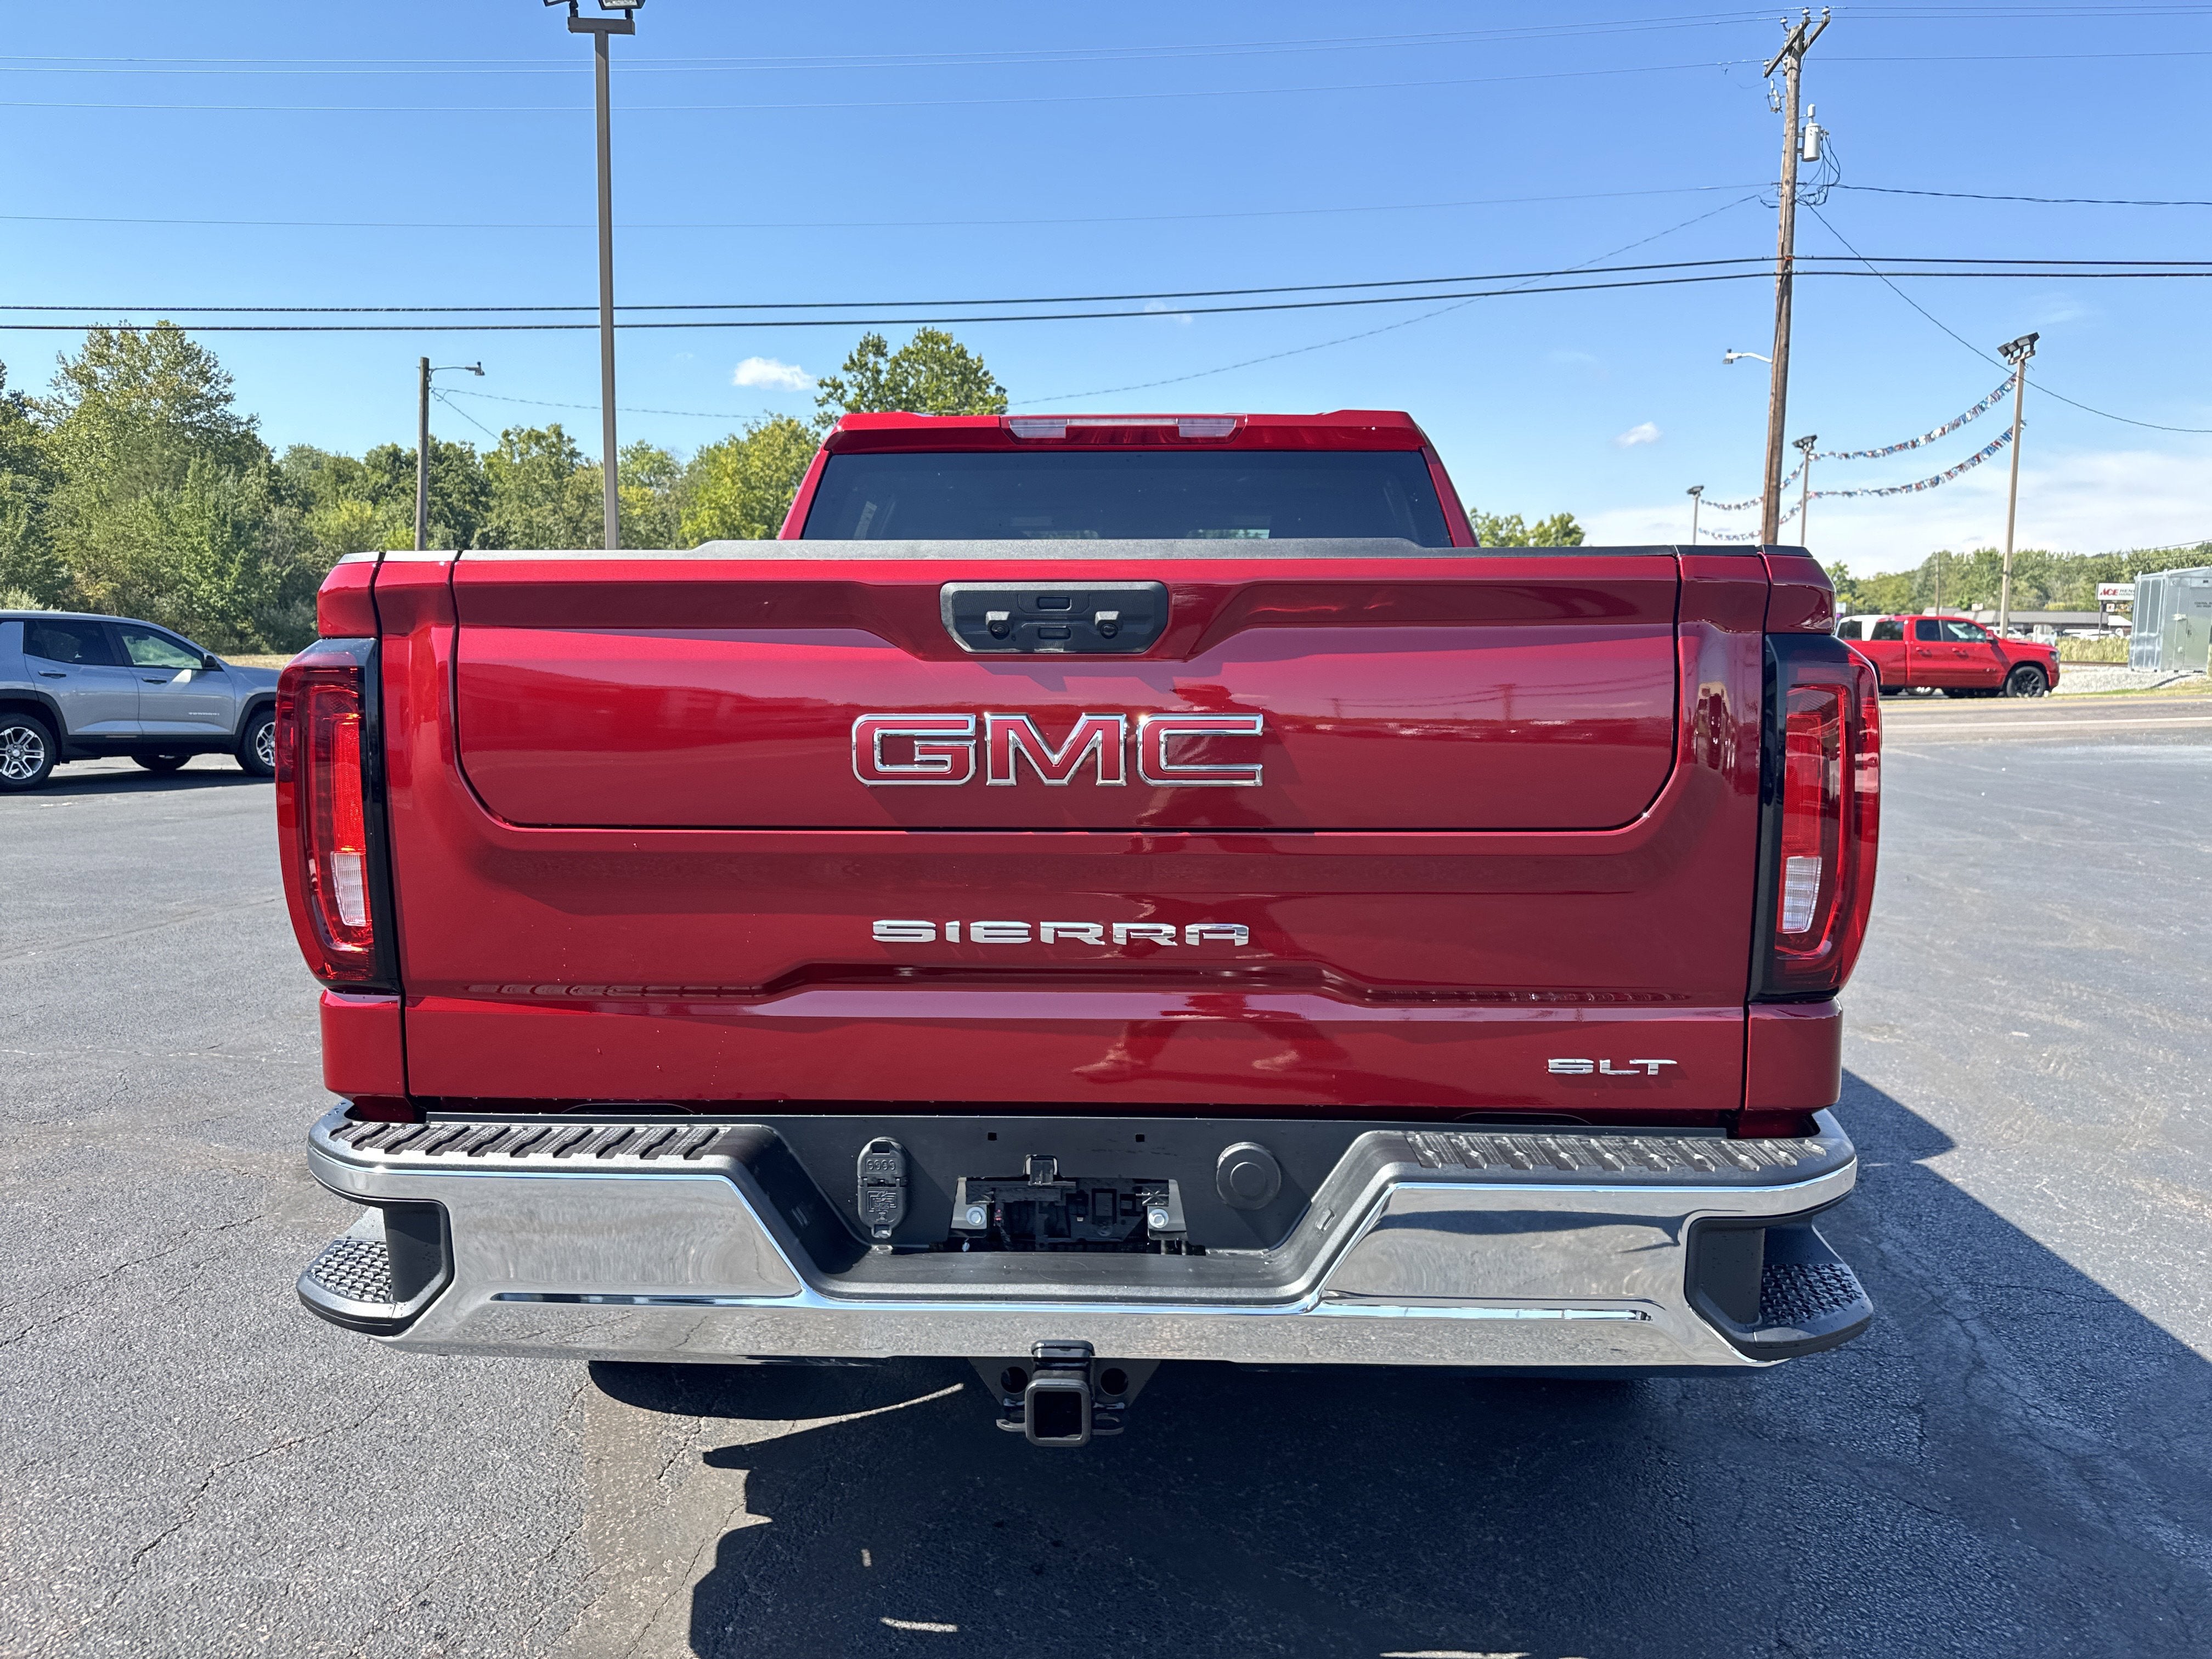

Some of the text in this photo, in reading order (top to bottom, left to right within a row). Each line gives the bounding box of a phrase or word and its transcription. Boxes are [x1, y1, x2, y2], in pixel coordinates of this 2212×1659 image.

[2100, 588, 2119, 596] ACE
[852, 713, 1263, 787] GMC
[873, 919, 1249, 946] SIERRA
[1548, 1058, 1678, 1075] SLT
